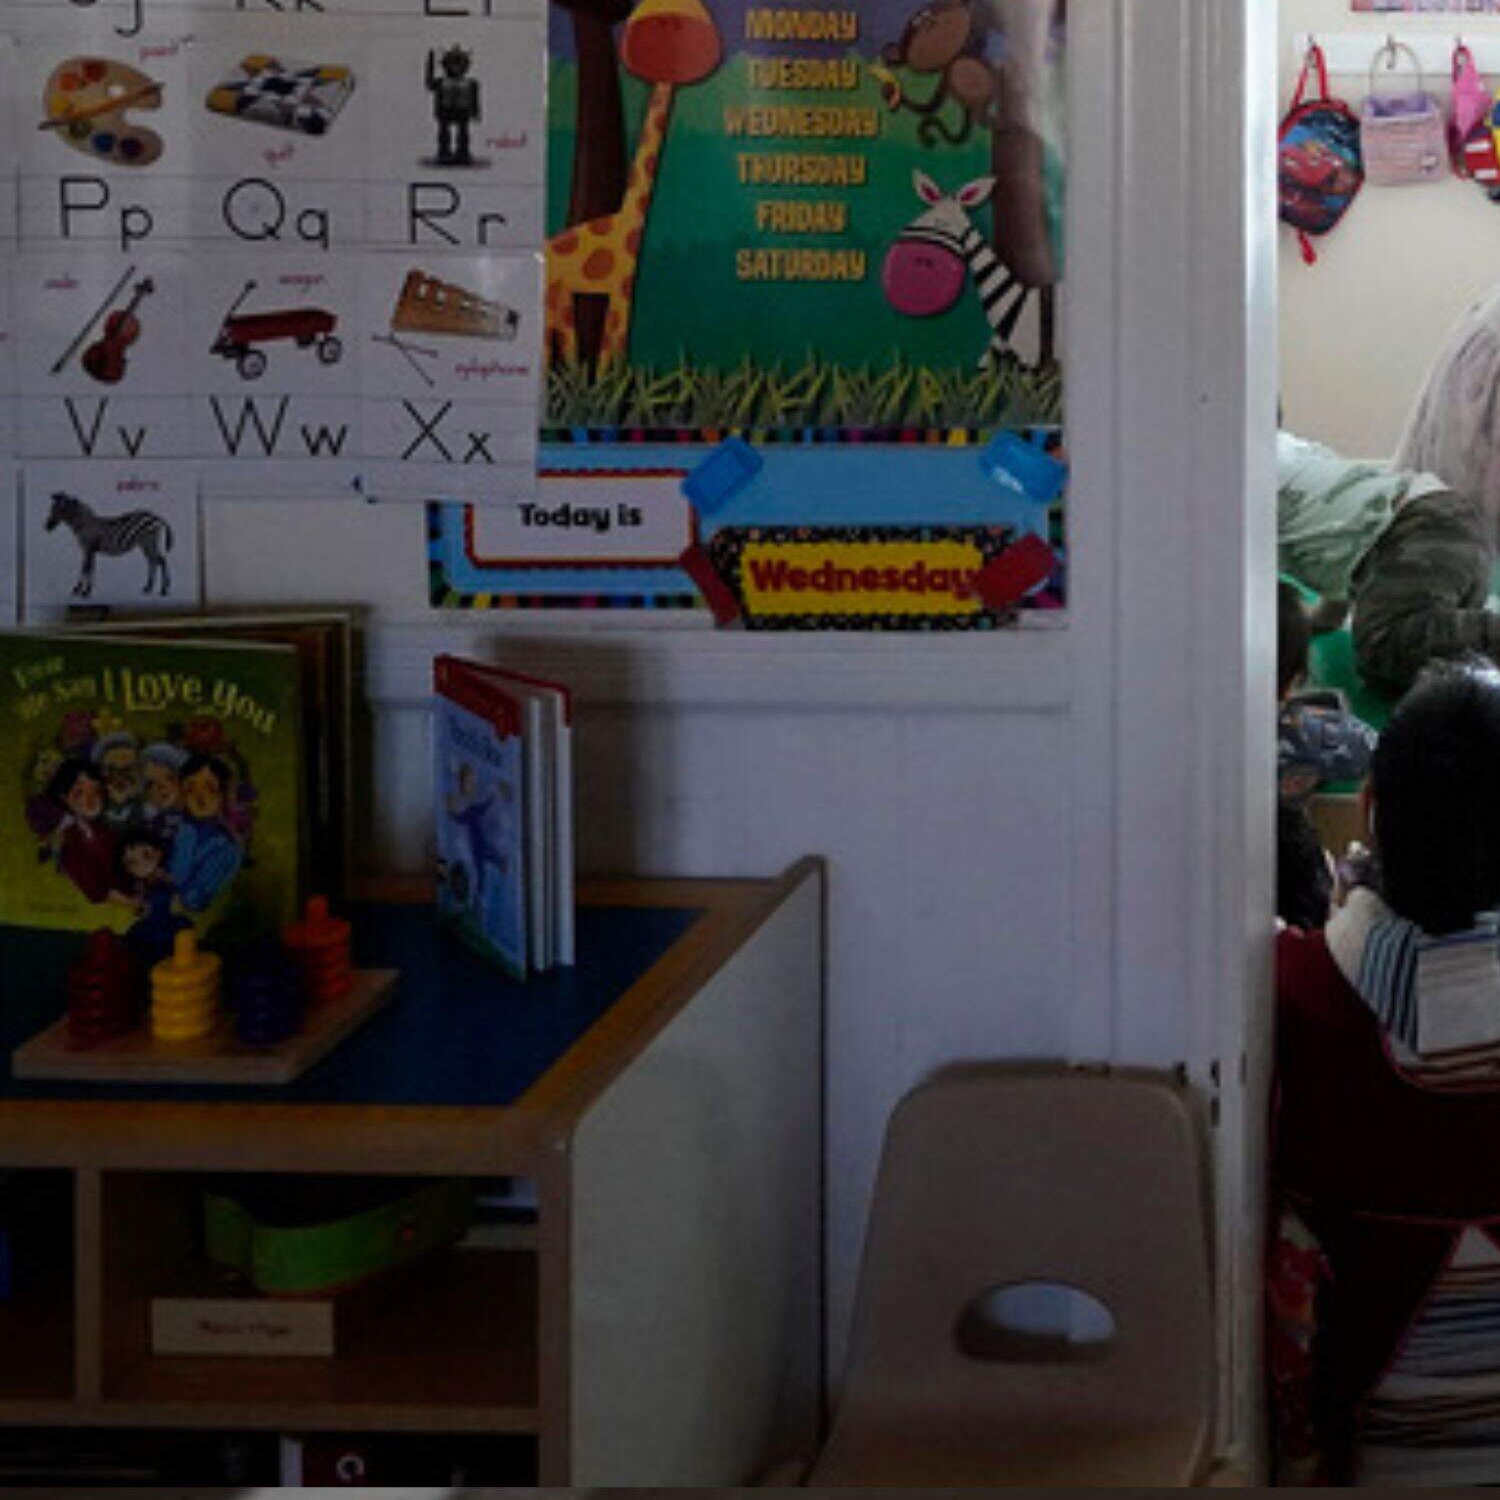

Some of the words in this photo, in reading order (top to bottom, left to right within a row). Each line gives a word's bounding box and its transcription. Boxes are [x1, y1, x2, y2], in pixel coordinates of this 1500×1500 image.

[745, 10, 858, 41] MONDAY
[746, 57, 860, 90] TUESDAY
[723, 107, 880, 139] WEDNESDAY
[736, 154, 867, 186] THURSDAY
[755, 201, 846, 233] FRIDAY
[735, 248, 867, 282] SATURDAY
[519, 504, 610, 532] Today
[618, 504, 642, 528] is
[748, 558, 984, 600] Wednesday
